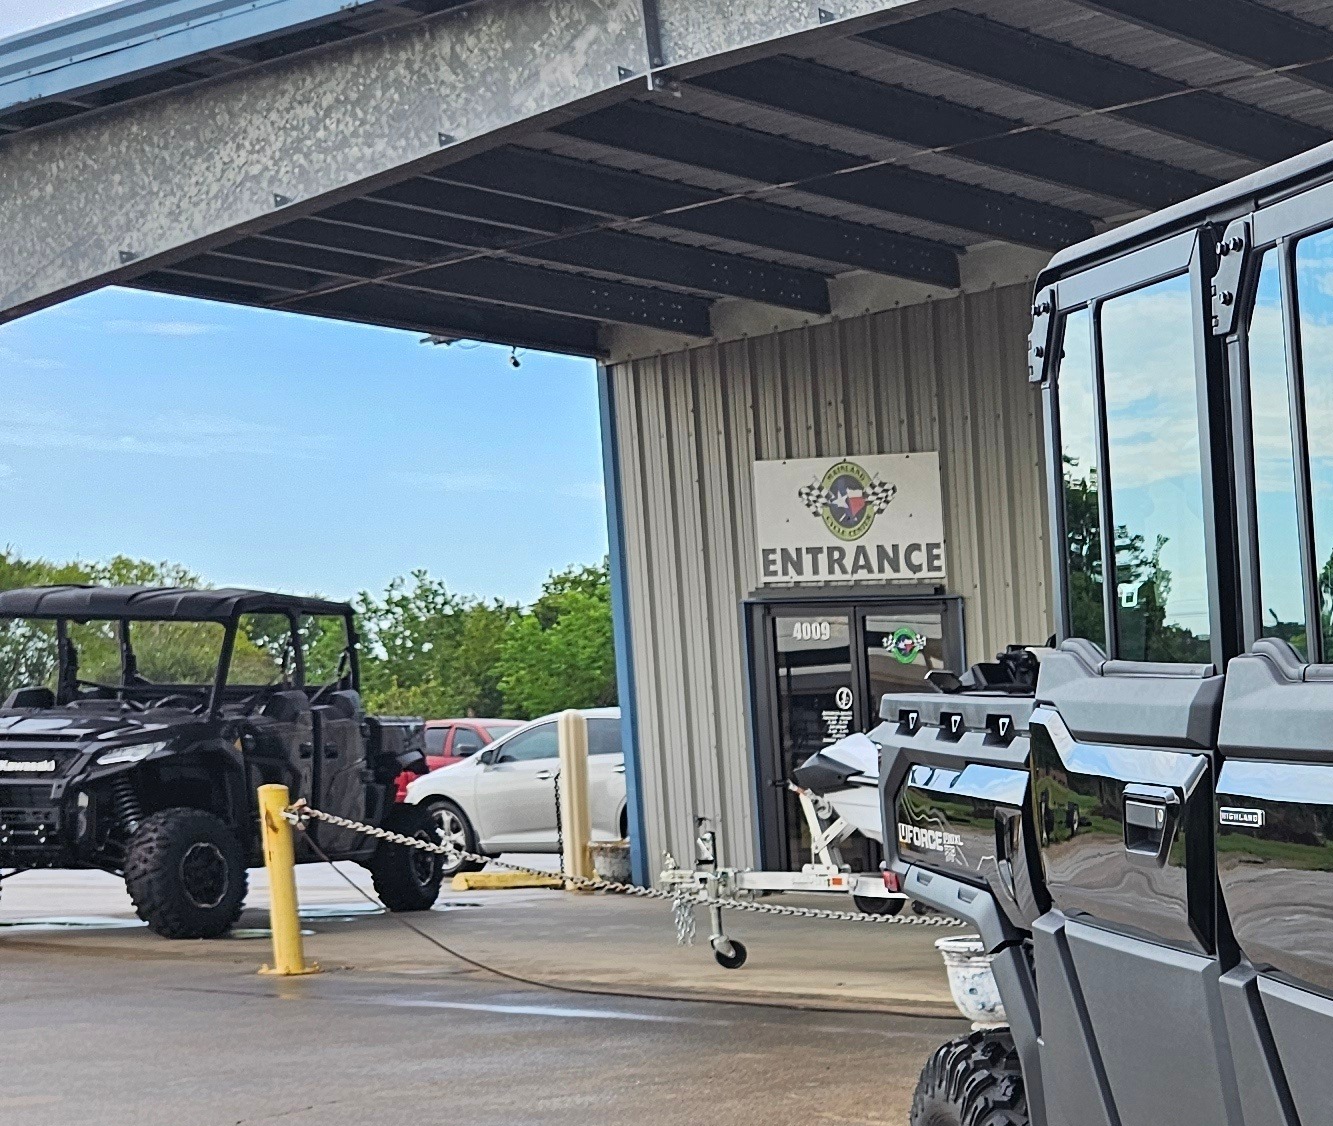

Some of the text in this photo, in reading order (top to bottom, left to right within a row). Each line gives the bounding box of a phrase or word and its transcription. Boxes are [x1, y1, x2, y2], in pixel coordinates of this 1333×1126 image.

[762, 542, 943, 578] ENTRANCE
[792, 621, 831, 640] 4009
[898, 822, 945, 852] UFORCE
